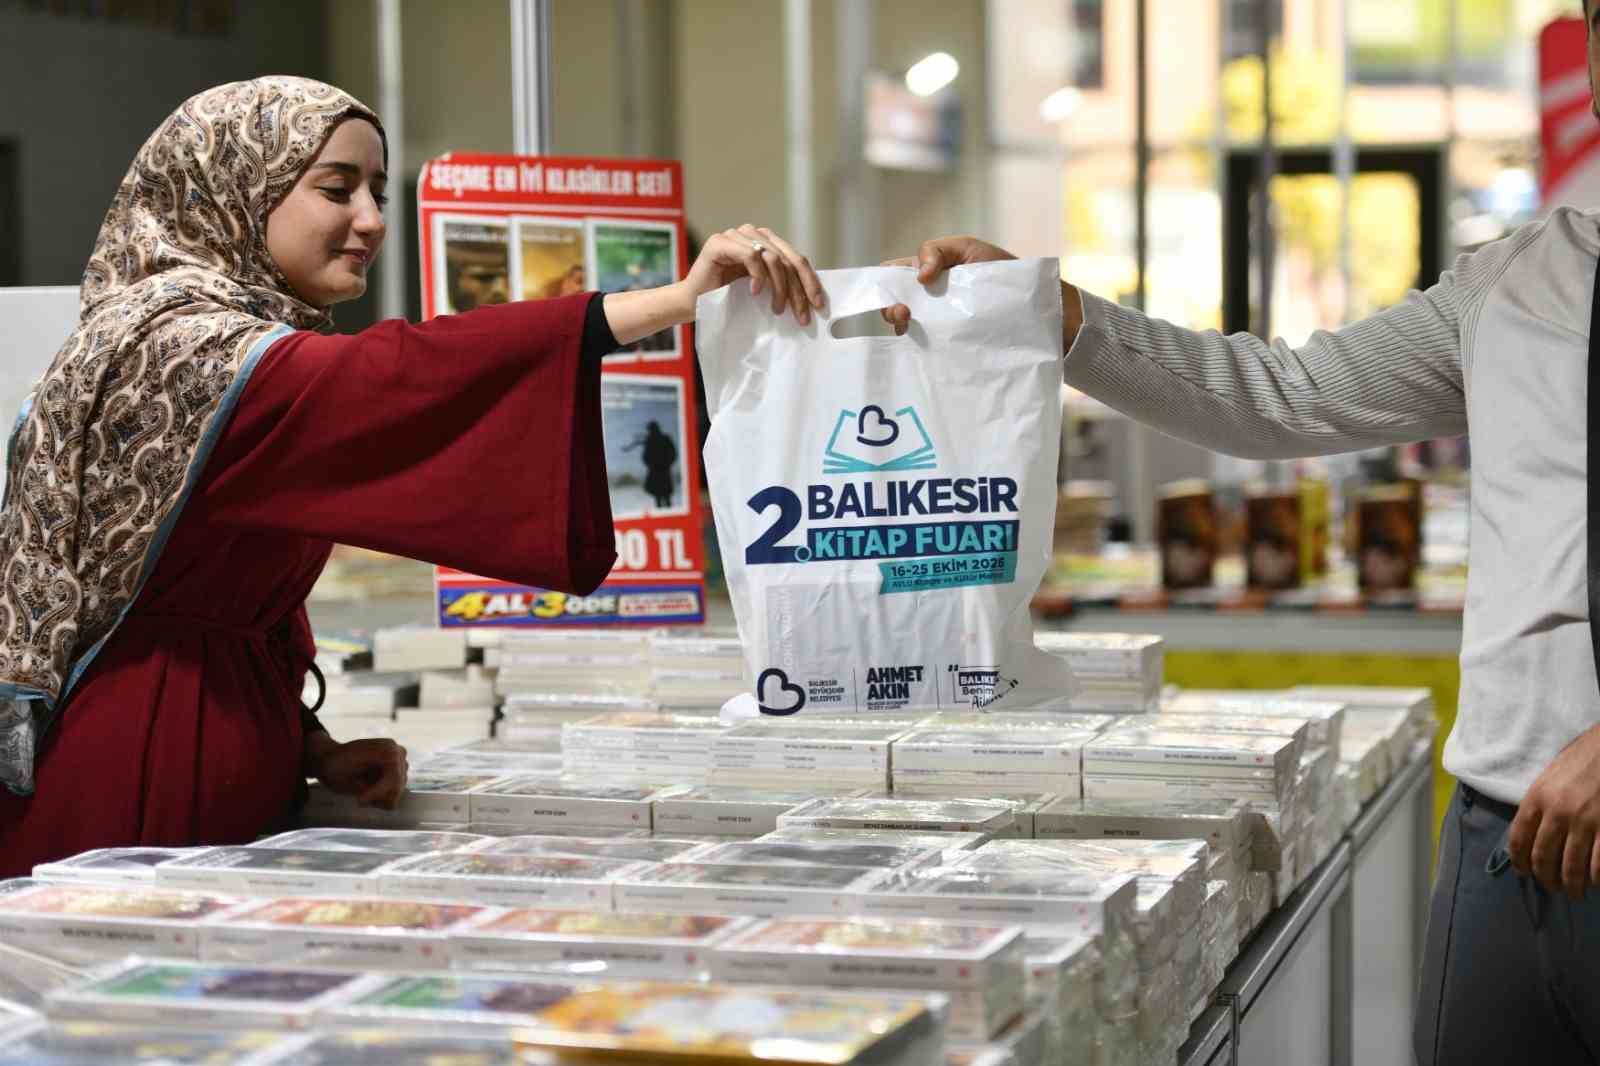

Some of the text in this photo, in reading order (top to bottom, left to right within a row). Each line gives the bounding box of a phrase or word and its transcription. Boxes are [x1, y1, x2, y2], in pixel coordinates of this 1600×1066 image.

[654, 529, 694, 570] TL
[915, 523, 1014, 553] FUARI
[892, 564, 929, 577] 16-25
[932, 559, 968, 574] EKİM
[446, 592, 486, 620] 4
[485, 593, 528, 614] AL
[531, 591, 566, 619] 3
[866, 666, 924, 684] AHMET
[867, 683, 910, 701] AKIN
